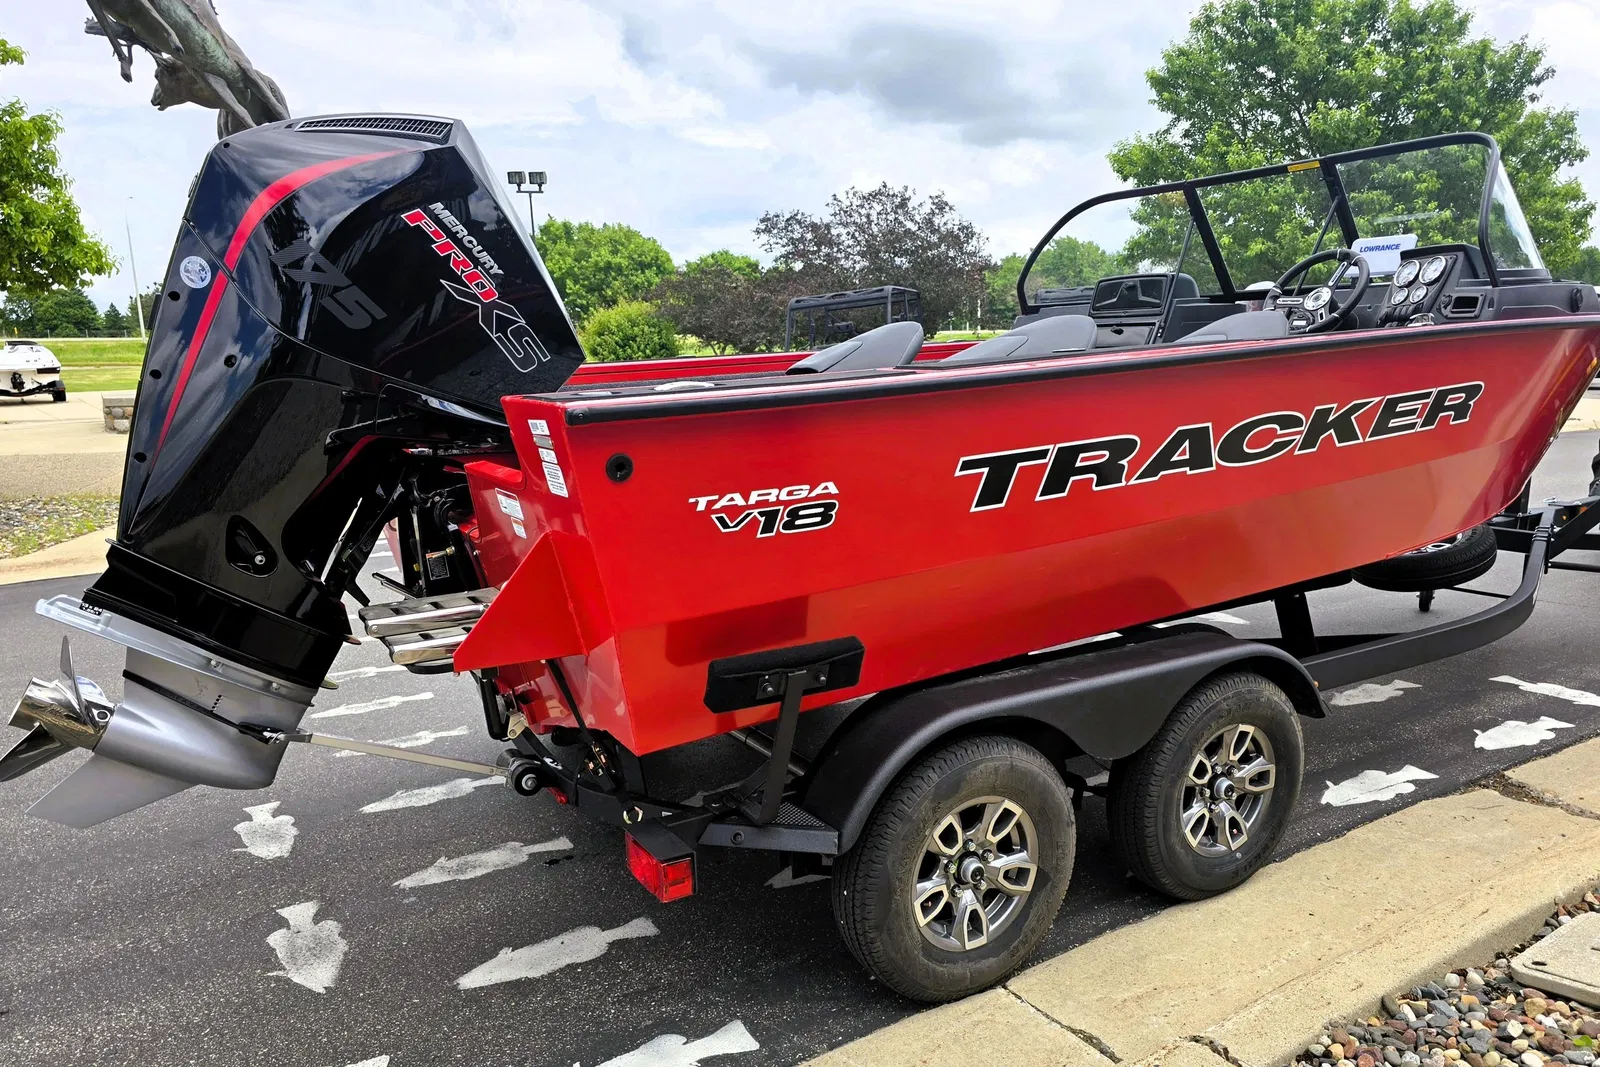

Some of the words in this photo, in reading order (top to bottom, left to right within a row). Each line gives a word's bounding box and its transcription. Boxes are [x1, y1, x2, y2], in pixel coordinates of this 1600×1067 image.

[401, 209, 498, 302] PRO
[429, 202, 504, 275] MERCURY
[1359, 243, 1401, 253] LOWRANCE
[440, 279, 551, 373] XS
[954, 381, 1485, 513] TRACKER
[688, 481, 839, 512] TARGA
[711, 500, 839, 538] V18
